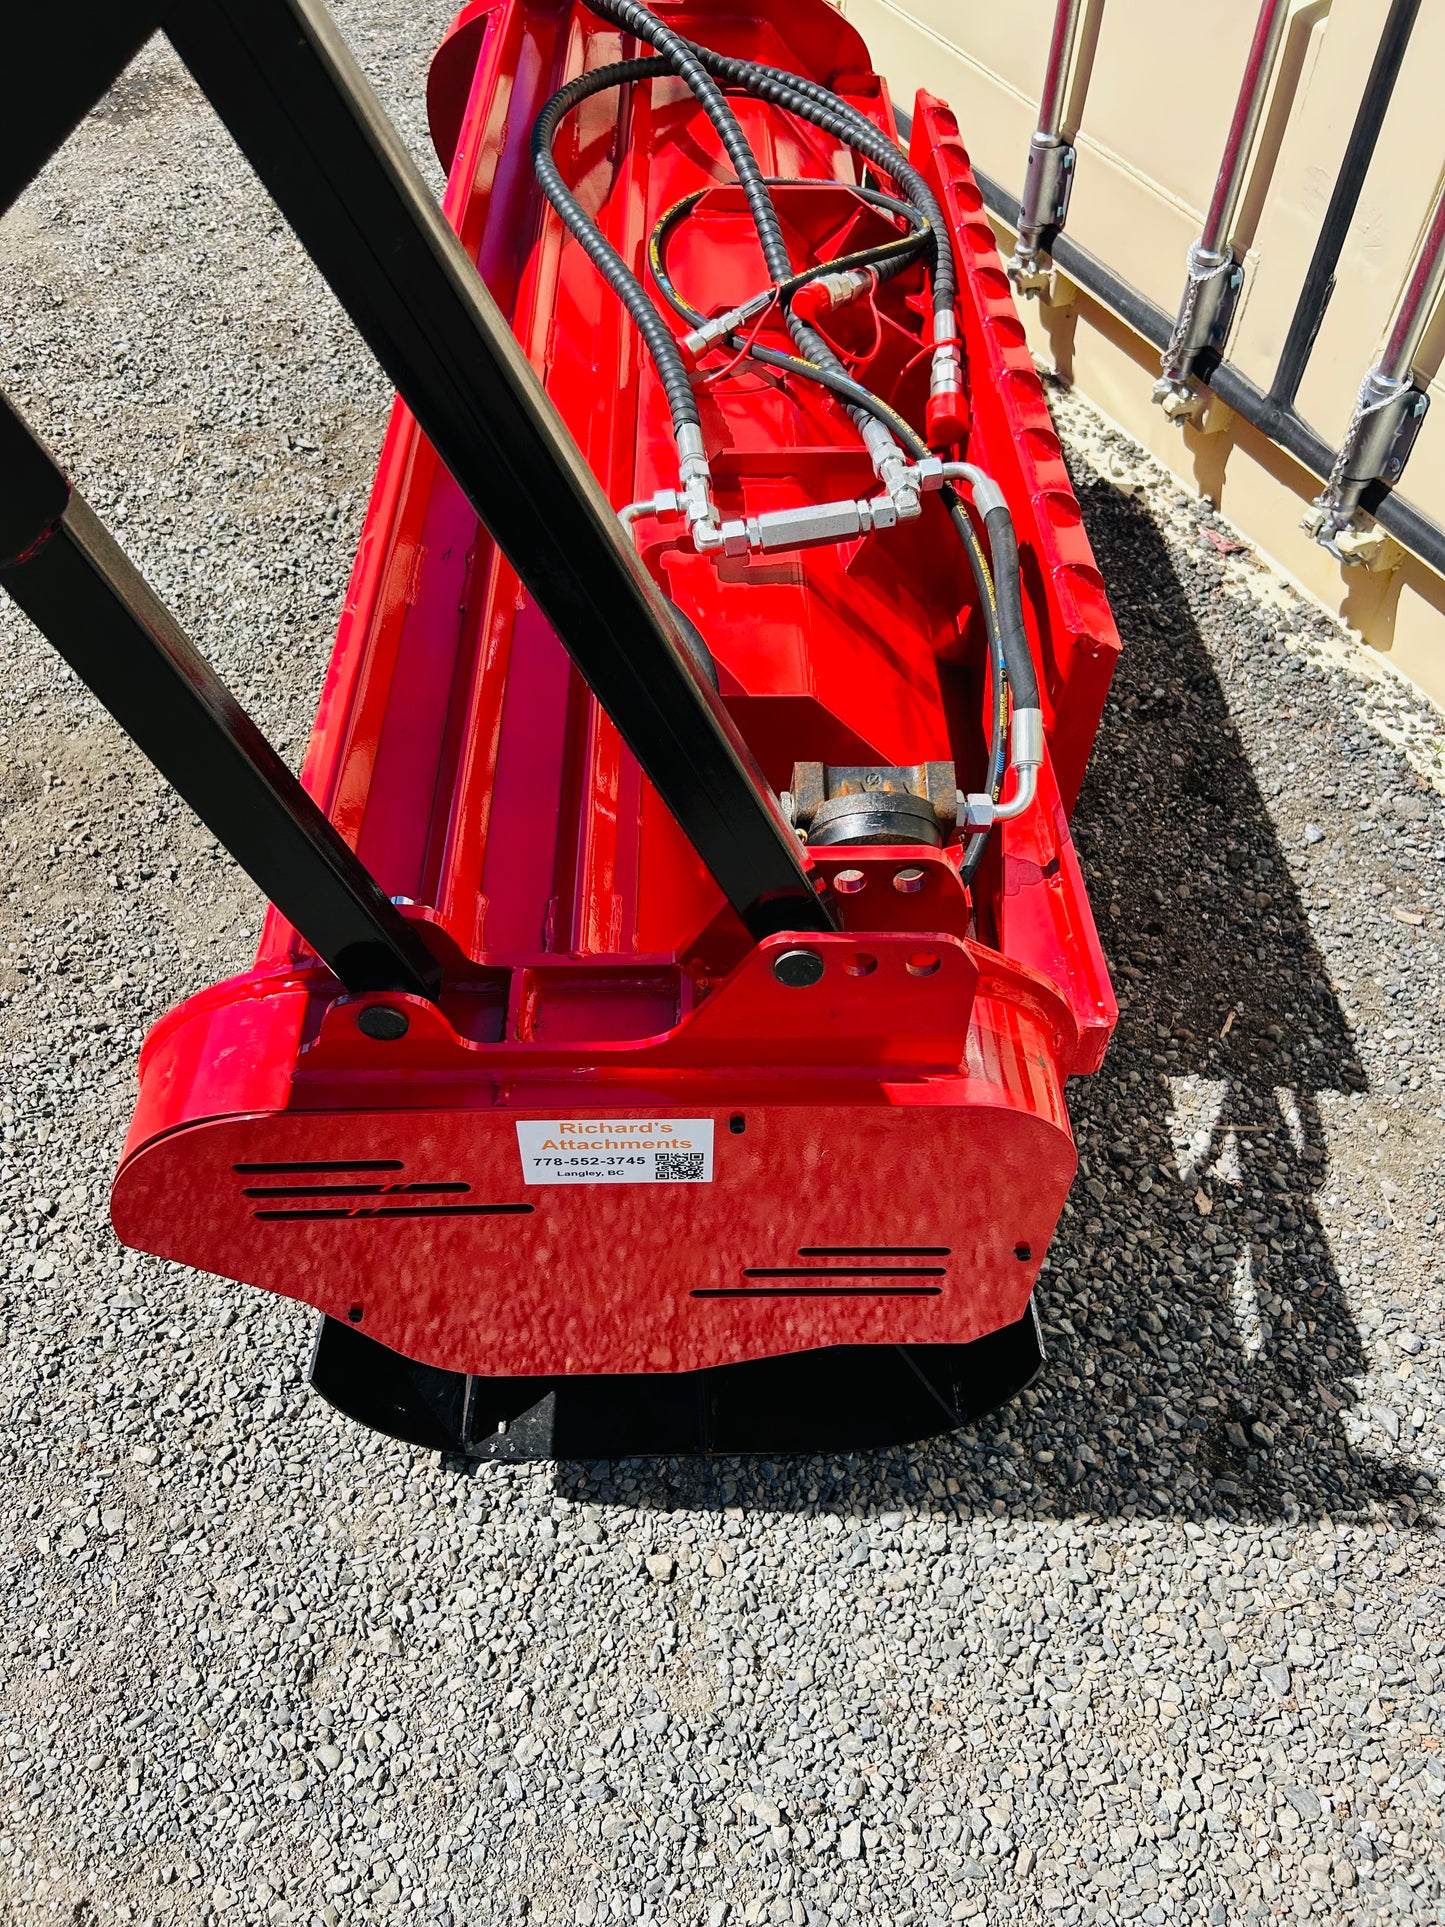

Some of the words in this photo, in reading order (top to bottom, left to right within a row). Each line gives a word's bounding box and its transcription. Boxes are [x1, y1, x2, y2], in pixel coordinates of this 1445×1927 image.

[559, 1121, 673, 1134] Richard's
[541, 1138, 692, 1151] Attachments
[533, 1156, 646, 1167] 778-552-3745
[557, 1170, 604, 1178] Langley,
[608, 1169, 625, 1177] BC
